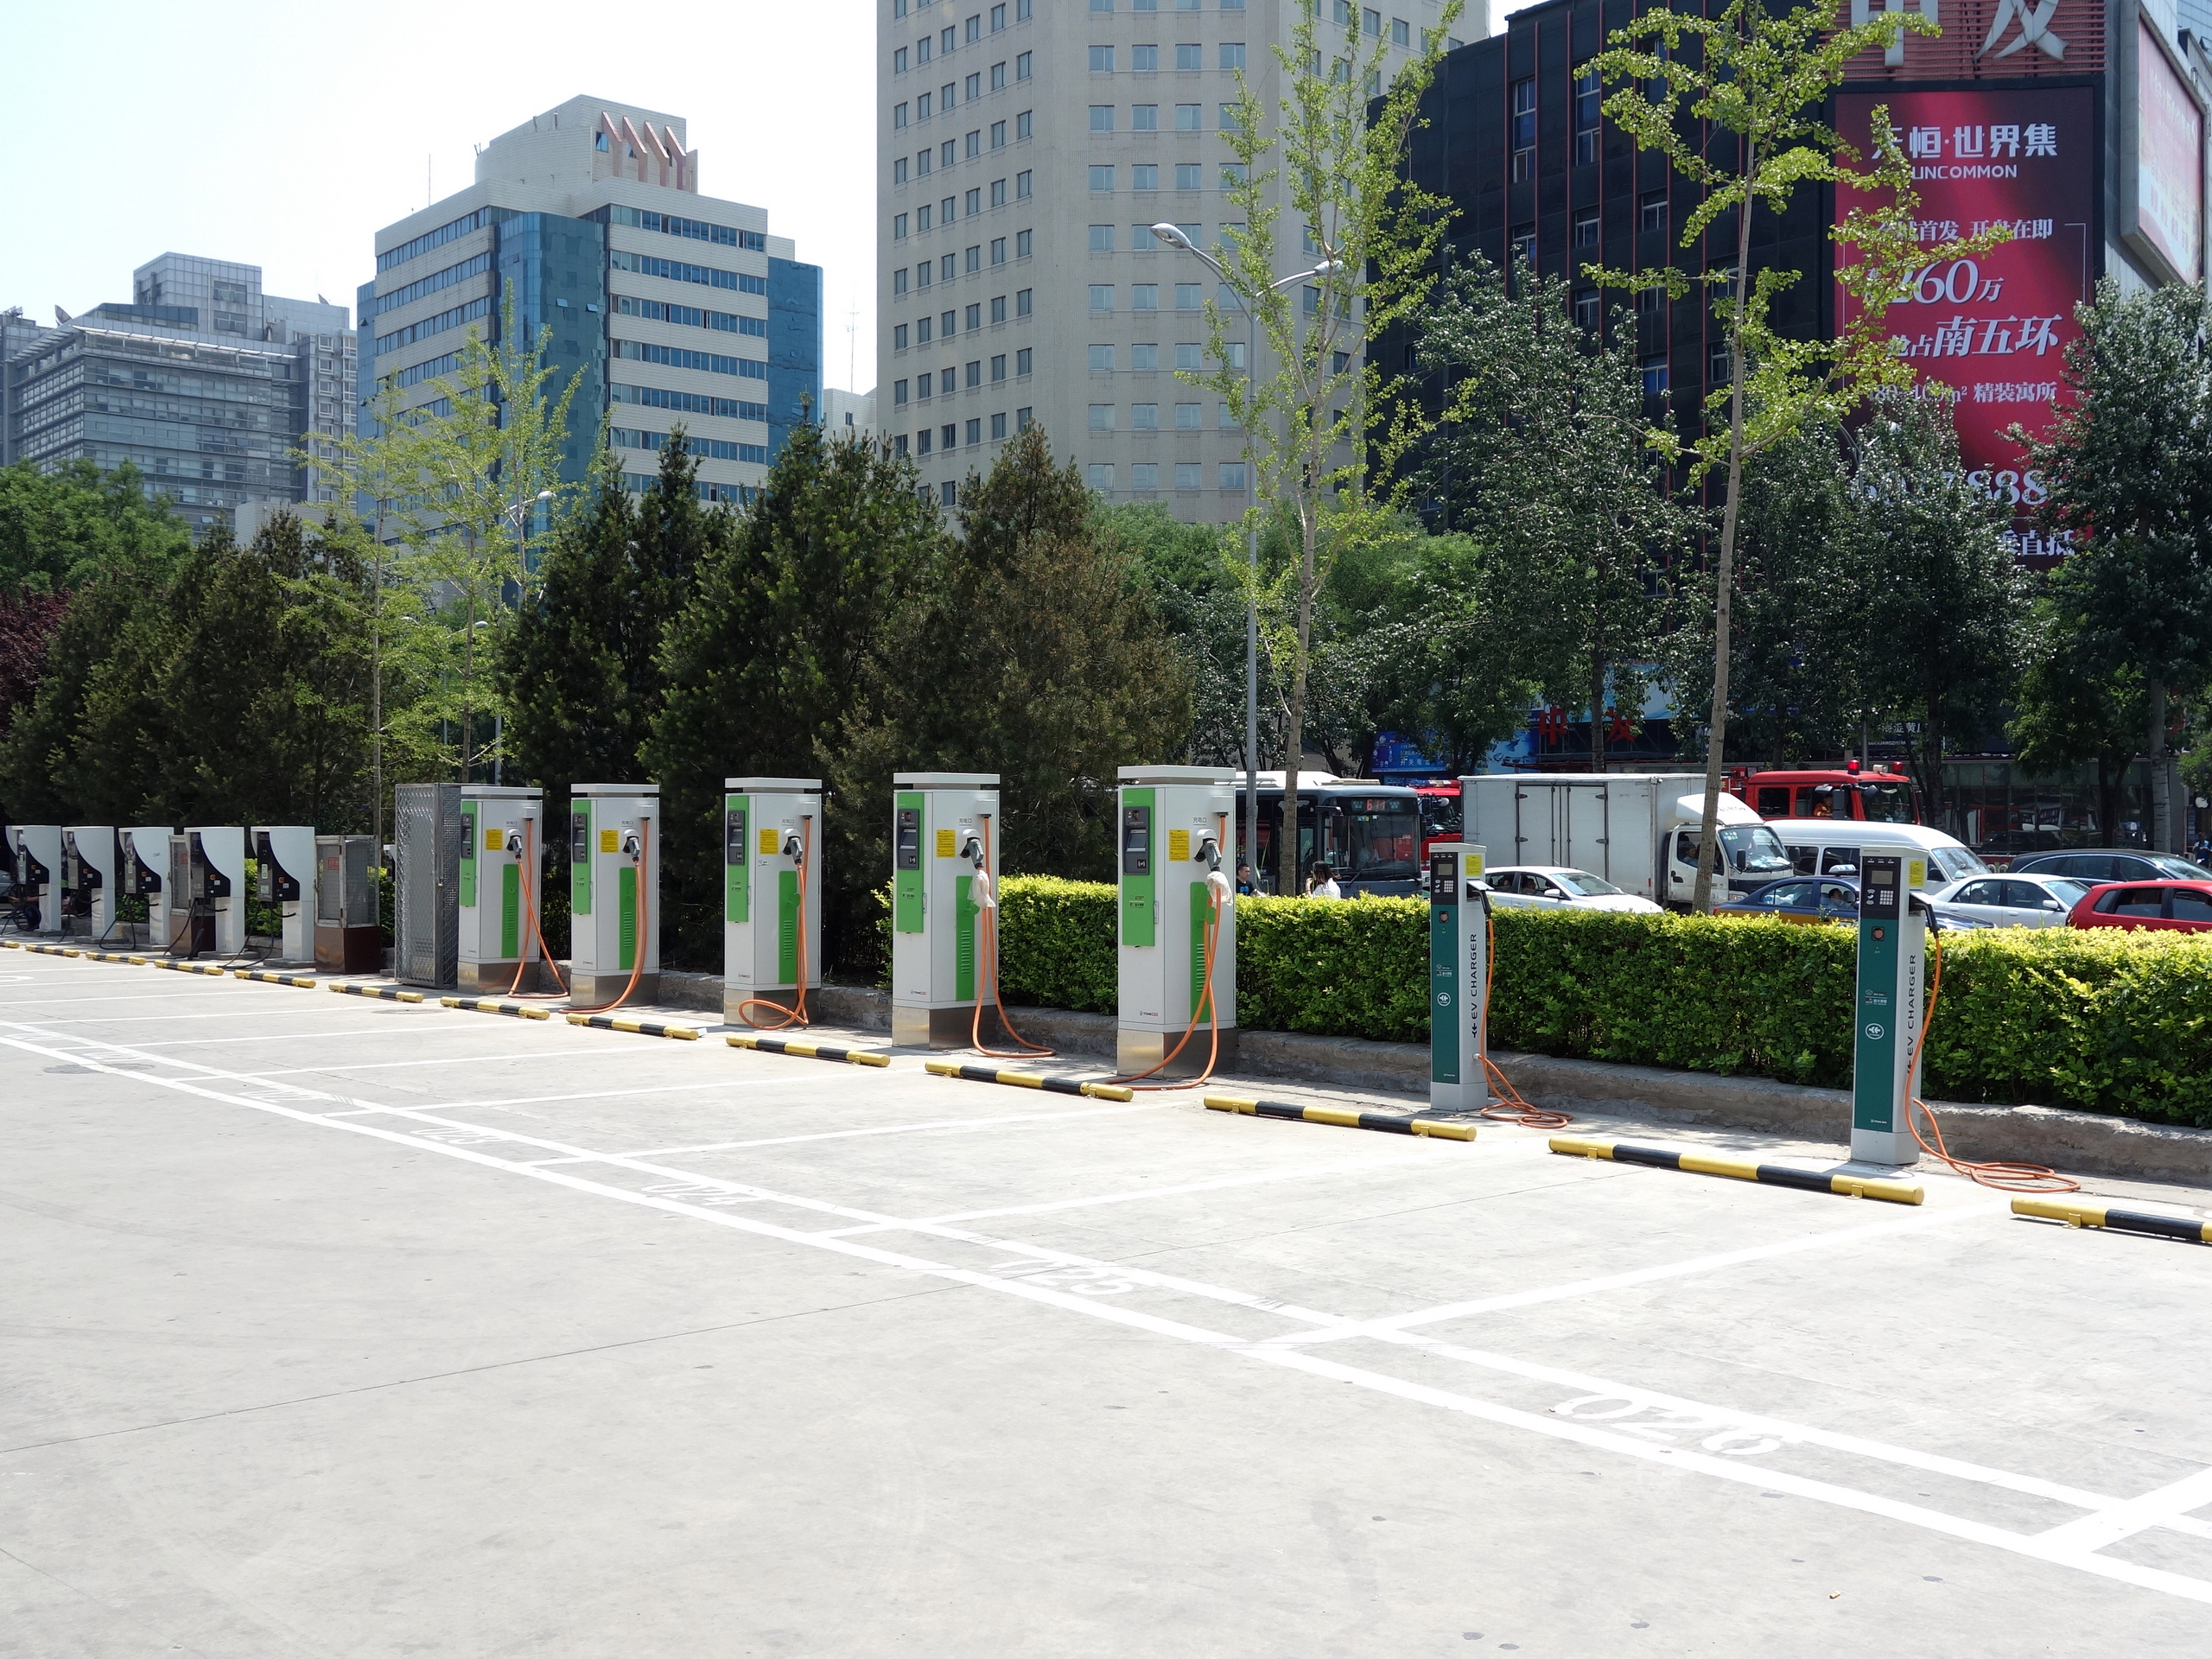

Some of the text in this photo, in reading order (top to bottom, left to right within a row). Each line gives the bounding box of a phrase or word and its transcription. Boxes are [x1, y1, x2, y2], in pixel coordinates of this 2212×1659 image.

[1911, 164, 2018, 180] UNCOMMON
[1973, 380, 2058, 404] 精装寓所
[1366, 798, 1386, 811] 611
[1471, 1002, 1478, 1020] EV
[1907, 954, 1916, 1058] EV CHARGER
[410, 1127, 508, 1145] 023
[641, 1182, 773, 1206] 024
[1553, 1393, 1783, 1456] 026
